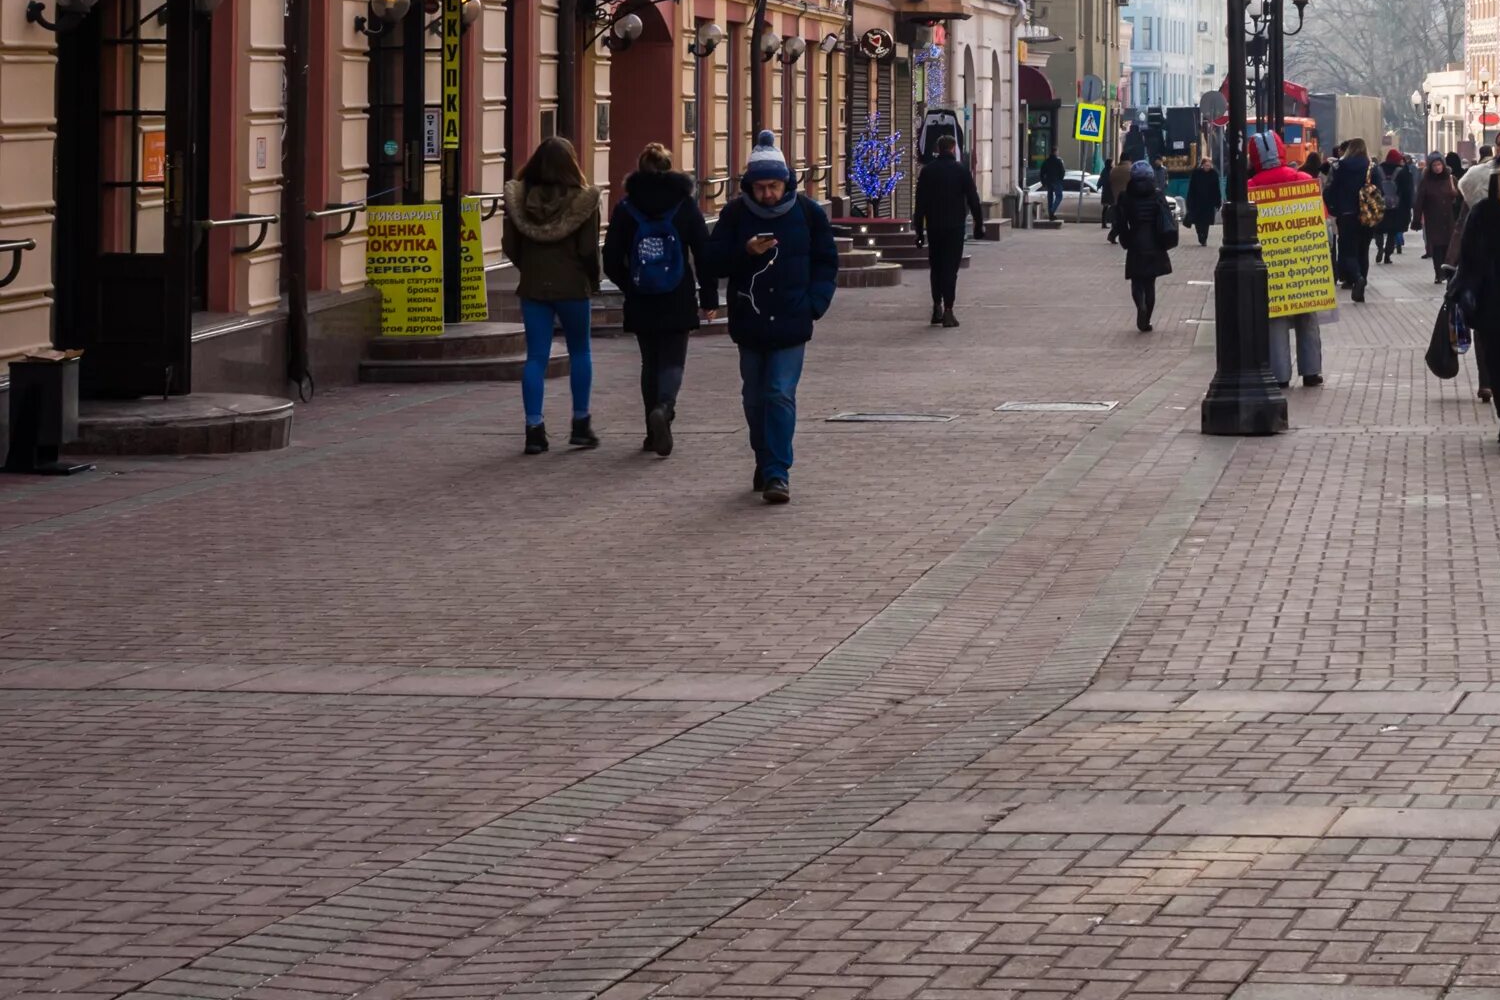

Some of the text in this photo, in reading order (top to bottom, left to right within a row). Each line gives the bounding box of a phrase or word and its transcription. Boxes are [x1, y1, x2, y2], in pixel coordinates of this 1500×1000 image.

[1286, 216, 1324, 231] ОЦЕНКА
[368, 224, 426, 238] ОЦЕНКА
[1282, 231, 1325, 243] серебро
[368, 256, 428, 265] ЗОЛОТО
[1300, 254, 1328, 264] чугун
[366, 265, 432, 274] СЕРЕБРО
[1288, 264, 1329, 279] фарфор
[1286, 276, 1330, 289] картины
[407, 285, 439, 295] бронза
[1288, 289, 1328, 300] монеты
[406, 324, 442, 334] другое
